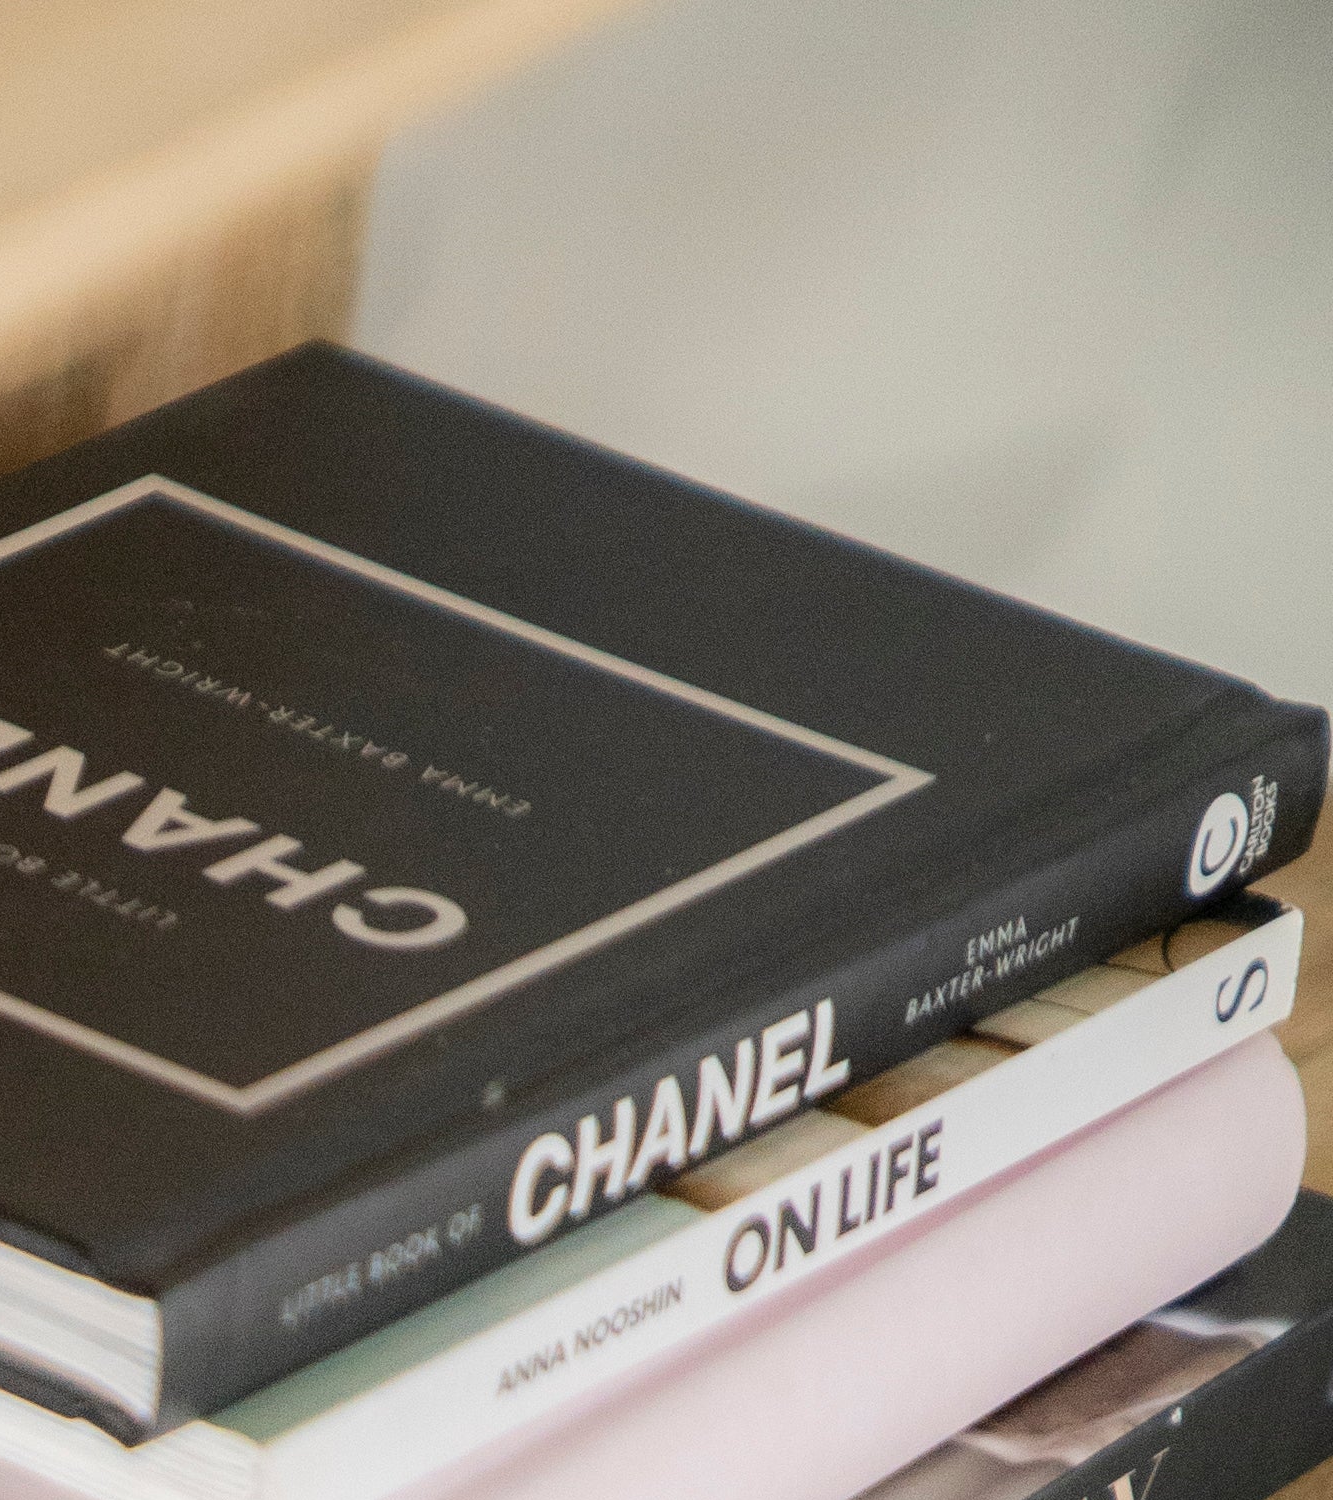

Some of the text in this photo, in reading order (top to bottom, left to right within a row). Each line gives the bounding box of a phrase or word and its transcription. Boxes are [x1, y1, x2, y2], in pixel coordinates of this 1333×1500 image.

[104, 642, 531, 817] EMMA BAXTER-WRIGHT
[1237, 773, 1266, 875] CARLTON
[1256, 780, 1279, 859] BOOKS
[52, 871, 178, 929] LITTLE
[966, 916, 1029, 964] EMMA
[905, 915, 1080, 1025] BAXTER-WRIGHT
[279, 998, 851, 1329] LITTLE BOOK OF CHANEL
[496, 1117, 944, 1397] ANNA NOOSHIN ON LIFE
